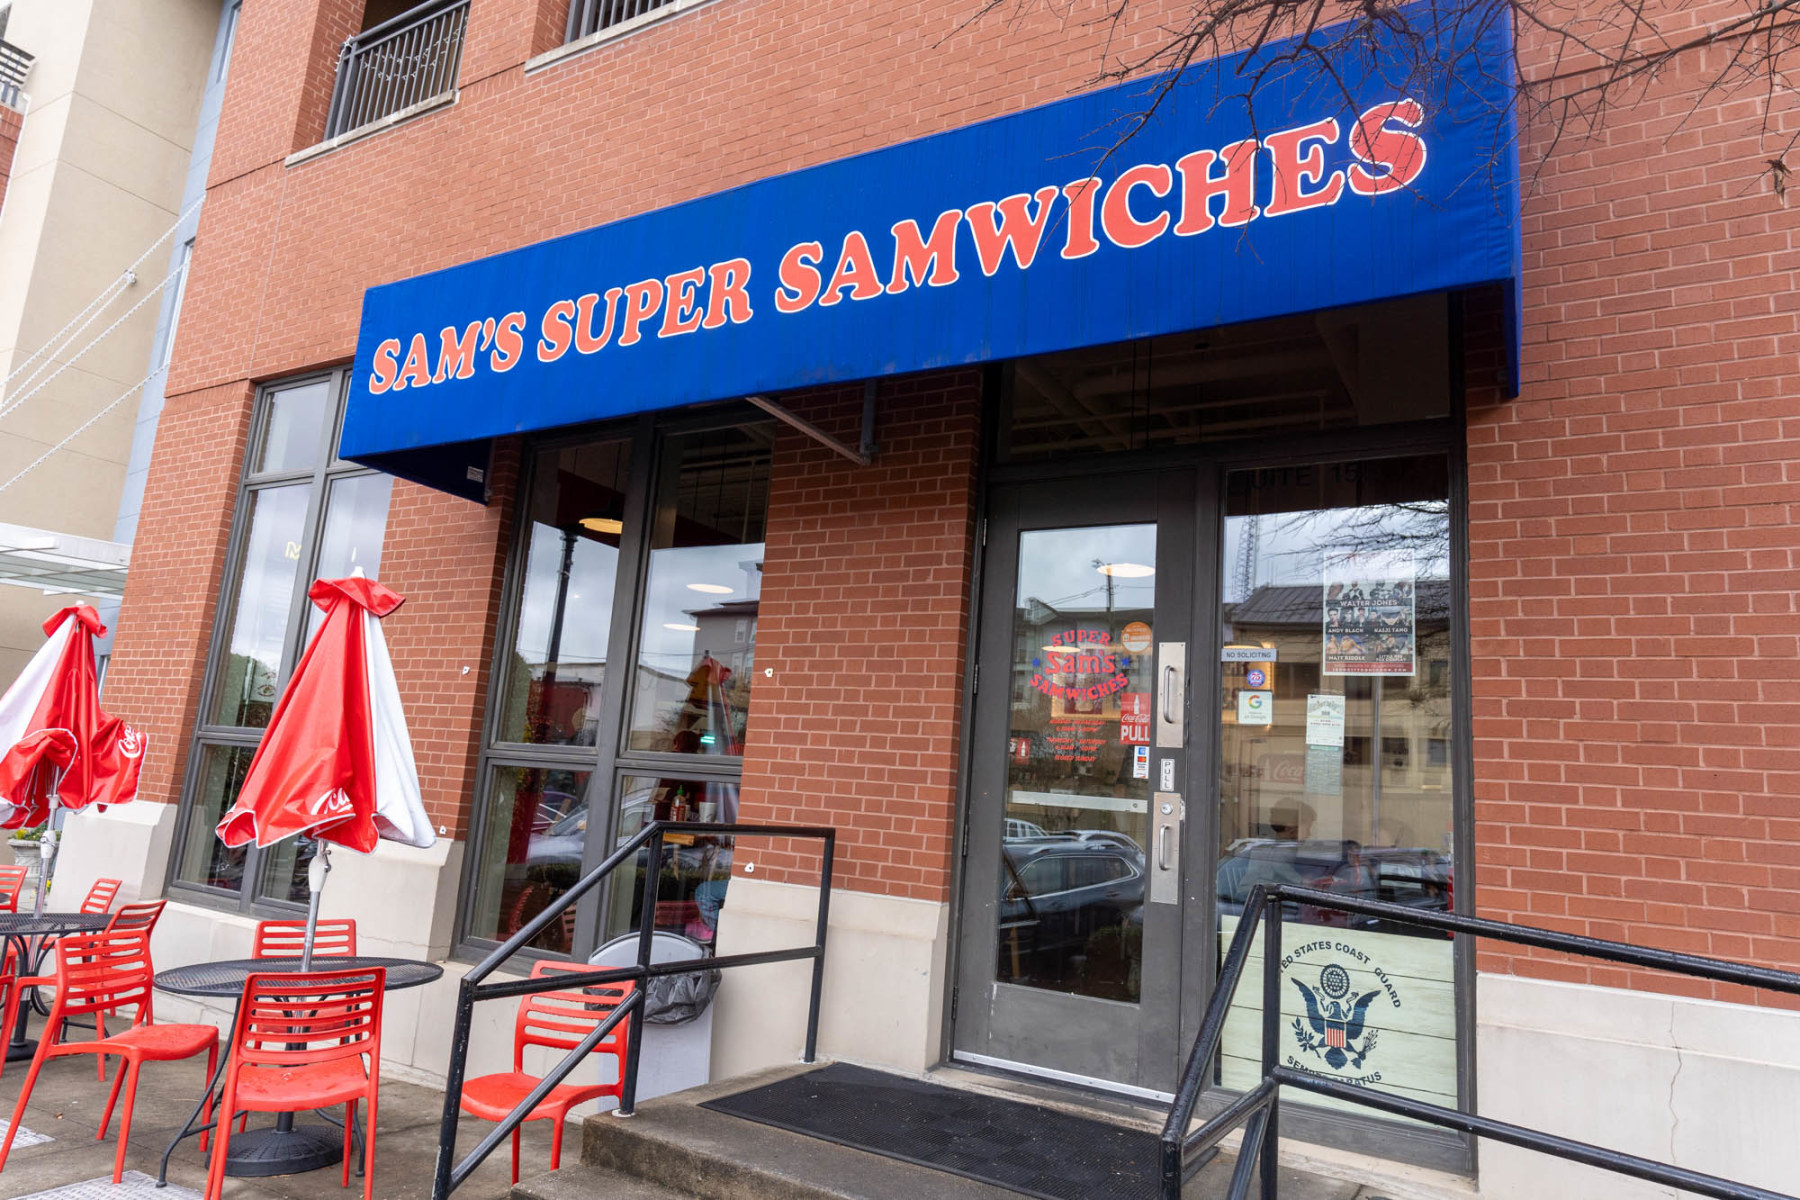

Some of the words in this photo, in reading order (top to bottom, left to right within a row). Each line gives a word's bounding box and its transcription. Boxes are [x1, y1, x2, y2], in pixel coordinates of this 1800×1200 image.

[368, 311, 526, 395] SAM'S
[537, 257, 753, 363] SUPER
[775, 98, 1427, 313] SAMWICHES
[1052, 629, 1111, 647] SUPER
[1045, 649, 1115, 675] Sam's
[1030, 672, 1128, 701] SAMWICHES
[1120, 724, 1151, 742] PULL
[1163, 761, 1172, 789] PULL
[1294, 941, 1332, 958] STATES
[1335, 942, 1371, 965] COAST
[1374, 967, 1402, 1008] GUARD
